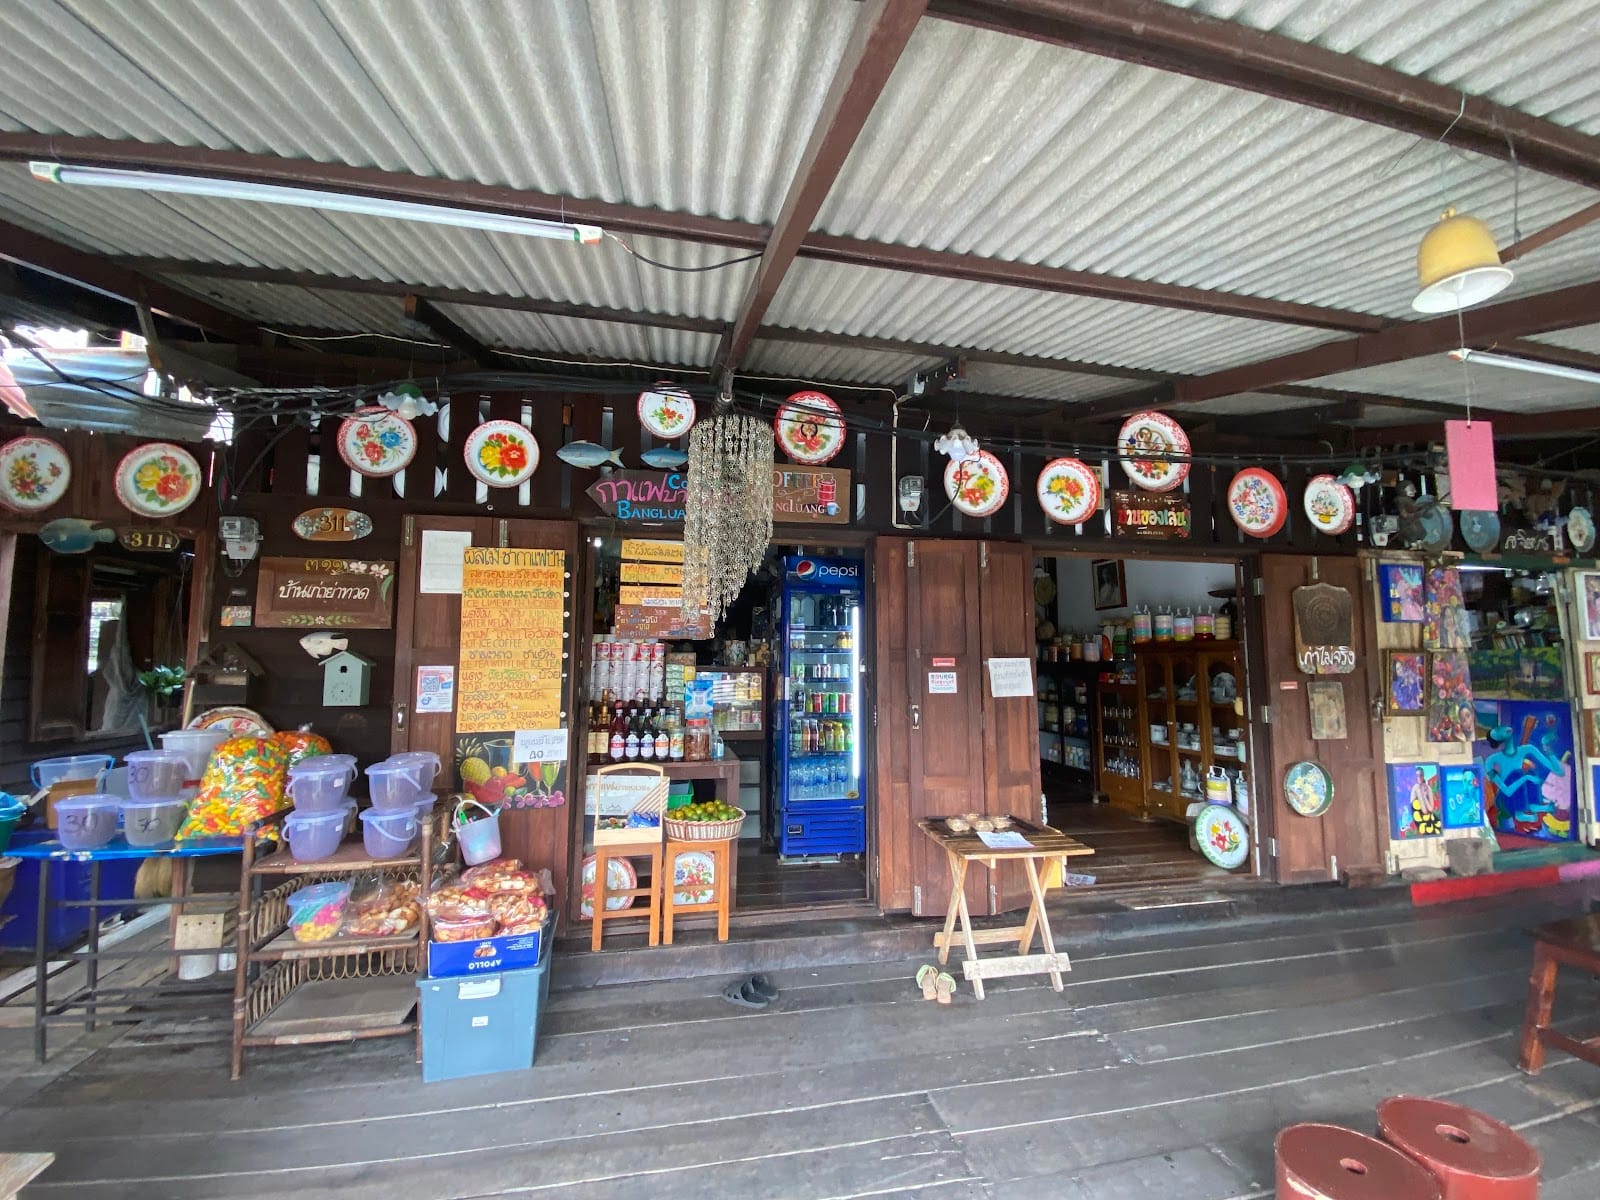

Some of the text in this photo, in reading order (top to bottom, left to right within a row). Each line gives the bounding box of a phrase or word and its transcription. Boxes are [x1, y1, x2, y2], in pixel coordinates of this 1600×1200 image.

[320, 513, 347, 532] 311
[131, 532, 165, 548] 311
[818, 565, 858, 578] pepsi
[279, 579, 370, 600] บ้านเก่าย่าทวด
[1298, 645, 1356, 666] เก่าไม่จริง
[63, 813, 98, 834] 30
[468, 959, 502, 970] APOLLO
